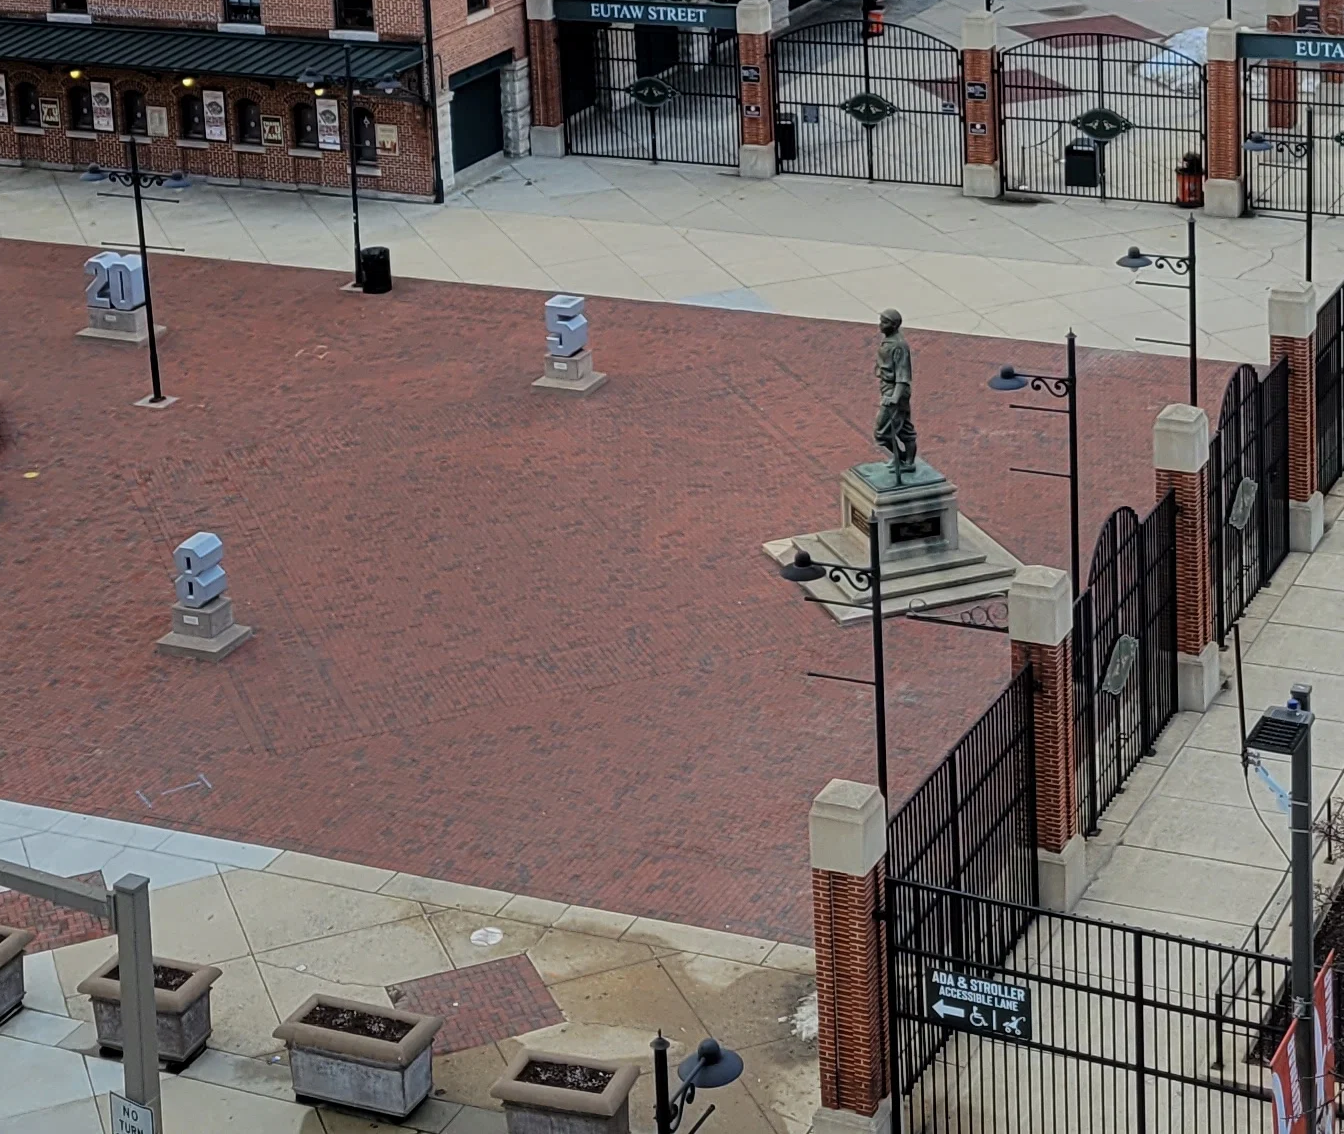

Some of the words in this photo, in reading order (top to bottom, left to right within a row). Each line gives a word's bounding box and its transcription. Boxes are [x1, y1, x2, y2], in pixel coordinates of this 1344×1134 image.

[590, 3, 644, 20] EUTAW
[648, 5, 707, 23] STREET
[84, 251, 146, 311] 20
[544, 294, 588, 357] 5
[173, 531, 227, 608] 8
[932, 970, 955, 986] ADA
[957, 976, 968, 990] &
[970, 979, 1025, 1002] STROLLER
[939, 985, 994, 1006] ACCESSIBLE
[995, 997, 1019, 1012] LANE
[122, 1105, 138, 1122] NO
